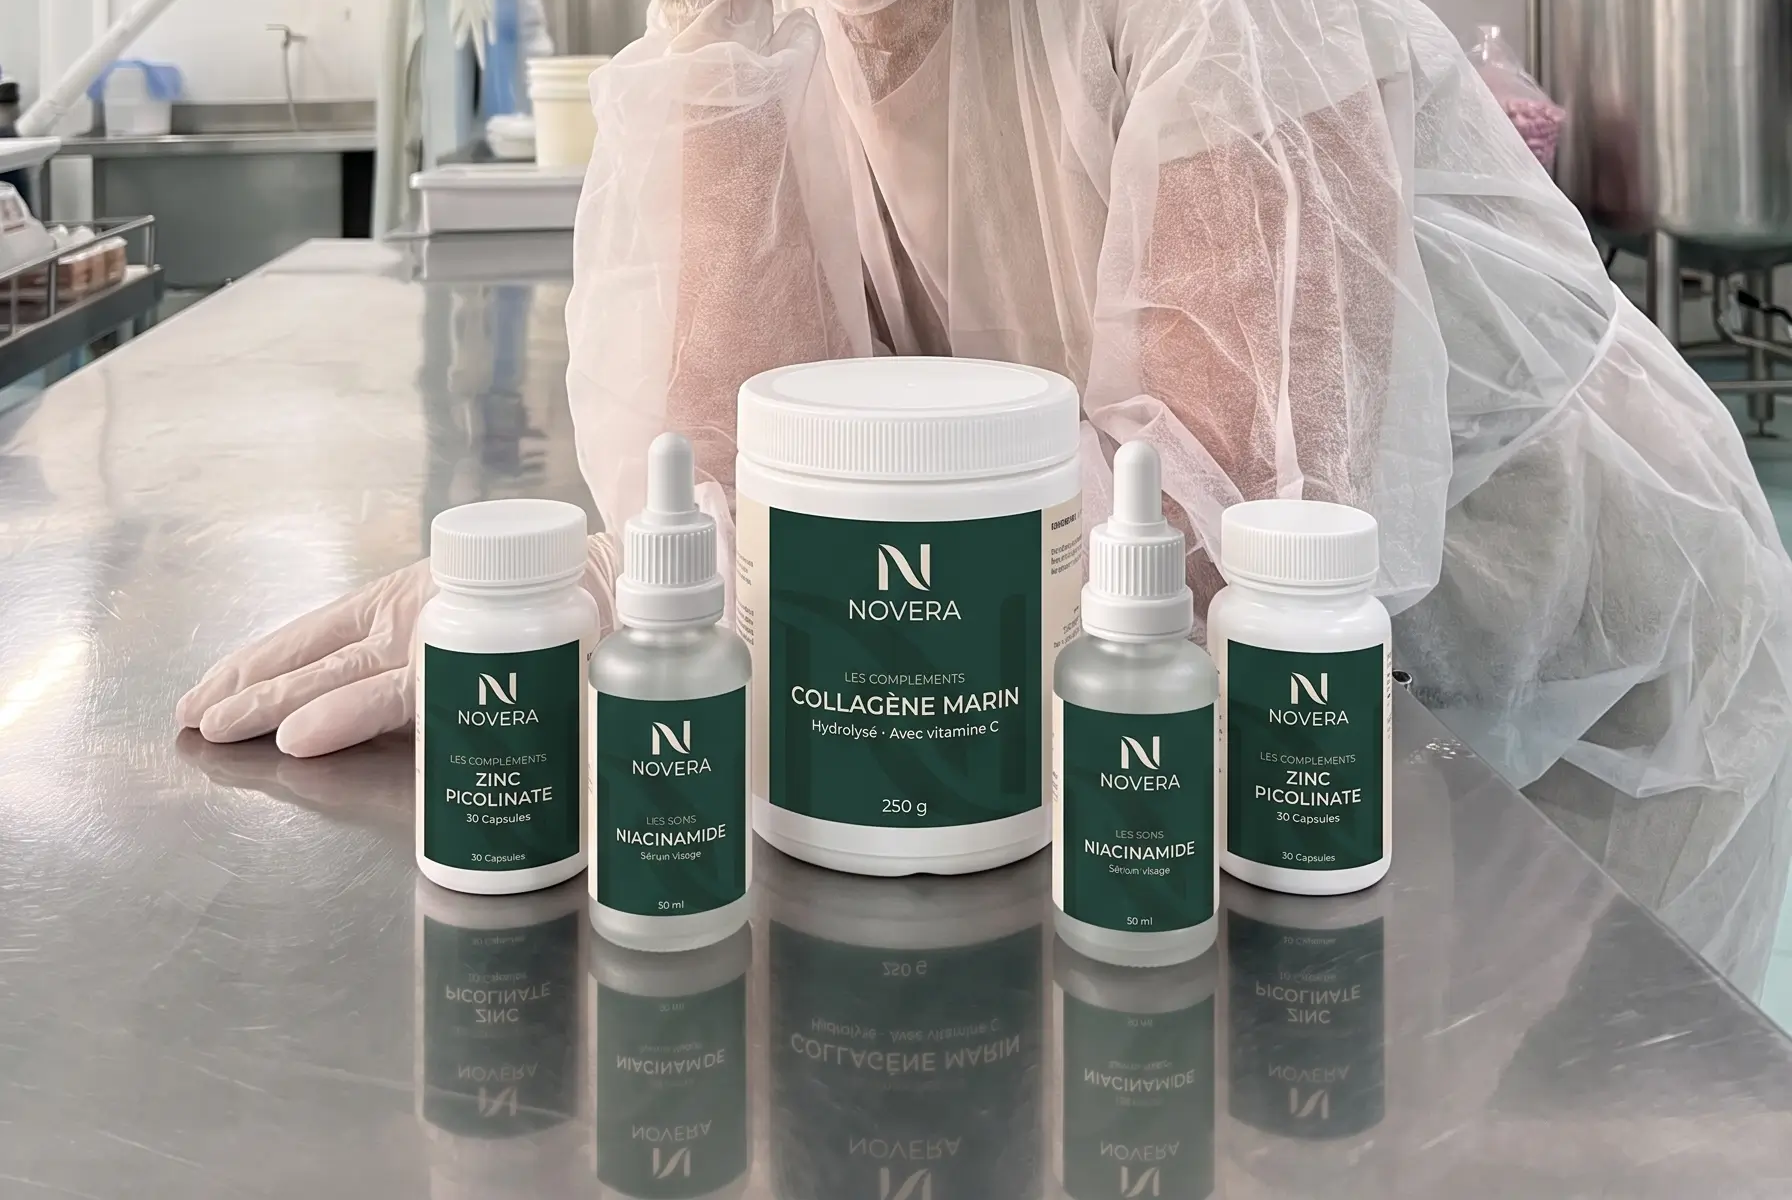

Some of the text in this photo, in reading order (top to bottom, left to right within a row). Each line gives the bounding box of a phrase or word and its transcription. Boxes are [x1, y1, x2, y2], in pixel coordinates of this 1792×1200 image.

[878, 543, 931, 591] N
[849, 599, 962, 621] NOVERA
[844, 672, 965, 686] LES COMPLEMENTS
[478, 672, 516, 705] N
[1290, 672, 1328, 705] N
[791, 686, 1020, 716] COLLAGÈNE MARIN
[457, 709, 539, 727] NOVERA
[1269, 708, 1350, 727] NOVERA
[652, 720, 691, 756] N
[812, 720, 999, 740] Hydrolysé Avec vitamine C
[450, 754, 467, 765] LES
[1121, 735, 1160, 770] N
[1260, 751, 1278, 763] LES
[632, 757, 712, 777] NOVERA
[475, 771, 521, 787] ZINC
[1100, 772, 1181, 791] NOVERA
[1286, 770, 1331, 786] ZINC
[446, 786, 553, 807] PICOLINATE
[1255, 784, 1362, 807] PICOLINATE
[882, 799, 927, 817] 250 g
[466, 813, 531, 826] 30 Capsules
[668, 815, 697, 825] SONS
[1276, 811, 1340, 825] 30 Capsules
[616, 823, 726, 847] NIACINAMIDE
[1115, 829, 1165, 840] LES SONS
[1084, 838, 1195, 860] NIACINAMIDE
[1282, 851, 1336, 864] 30 Capsules
[471, 853, 526, 864] 30 Capsules
[658, 900, 684, 910] 50 ml
[1126, 917, 1153, 926] 50 ml
